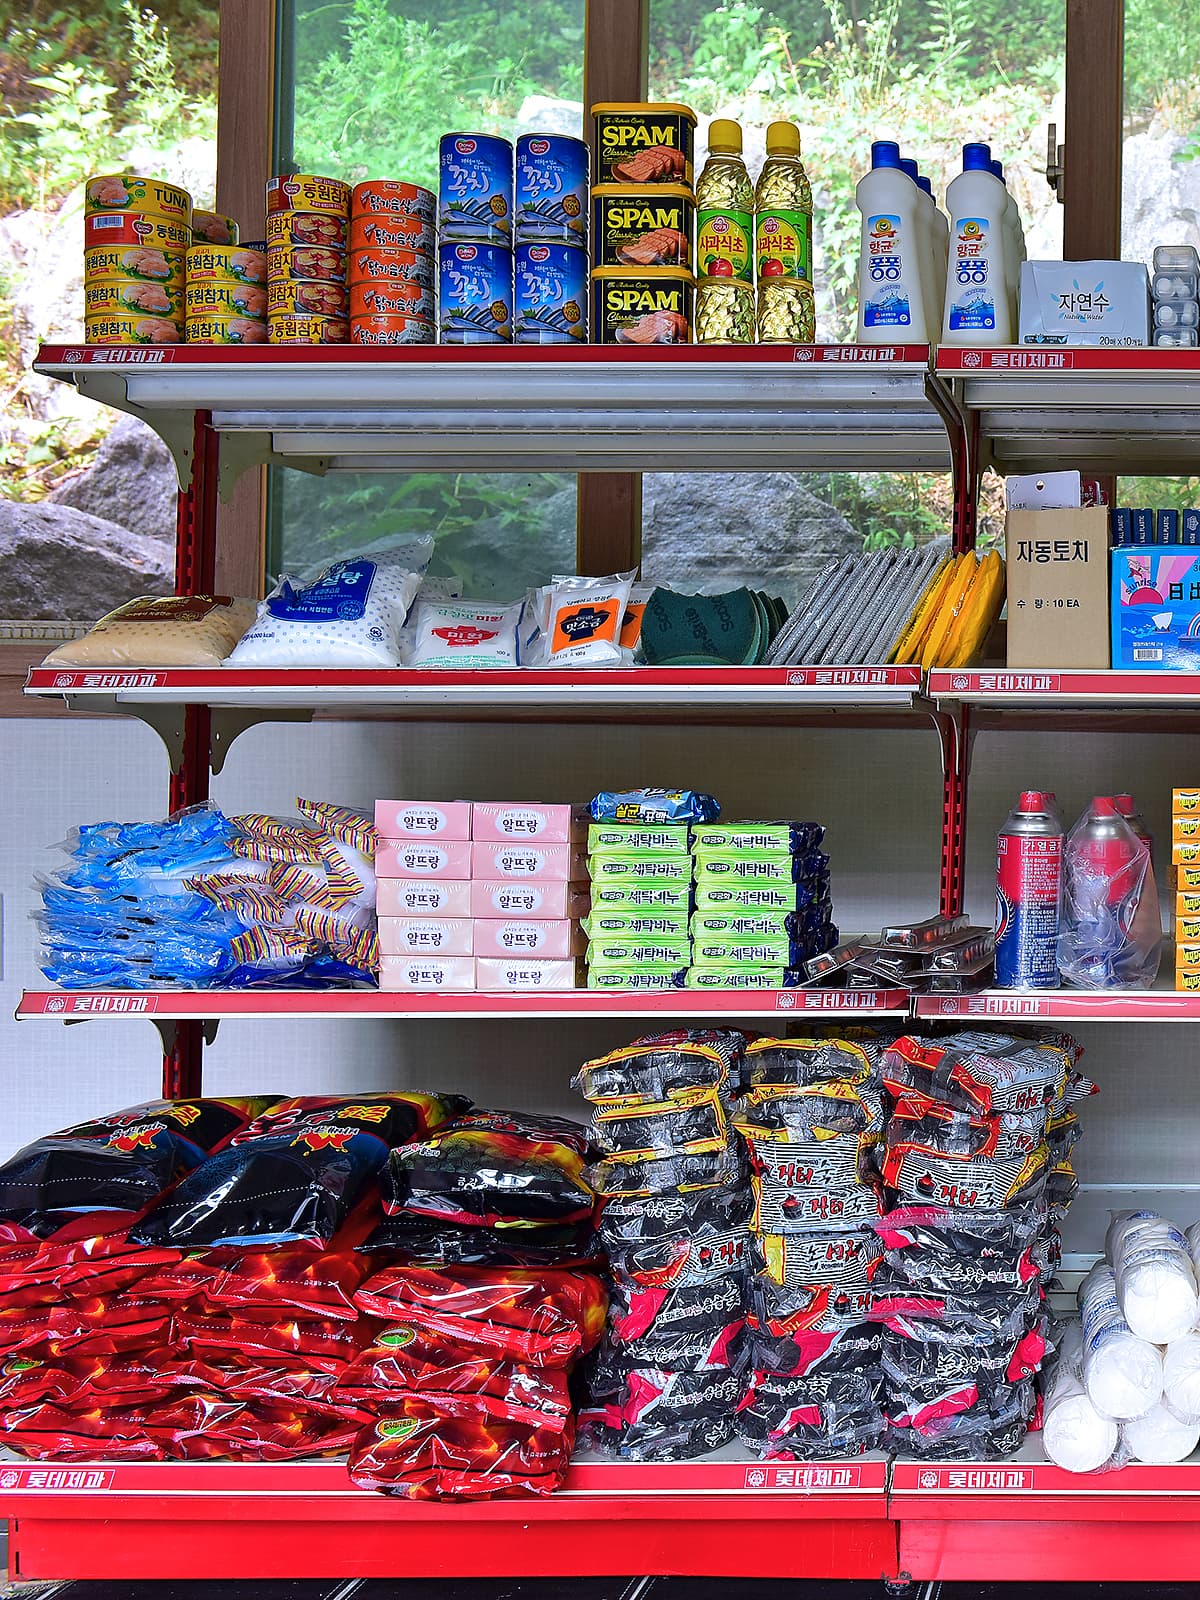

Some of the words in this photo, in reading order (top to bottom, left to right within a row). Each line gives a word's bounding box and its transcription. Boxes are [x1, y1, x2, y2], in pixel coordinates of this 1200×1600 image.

[602, 126, 674, 146] SPAM
[448, 165, 490, 197] 꽁치
[522, 165, 563, 197] 꽁치
[154, 188, 188, 209] TUNA
[369, 195, 413, 215] 닭가슴살
[606, 208, 679, 229] SPAM
[374, 228, 418, 249] 닭가슴살
[700, 235, 744, 252] 사과식초
[869, 241, 892, 255] 항균
[957, 244, 980, 258] 항균
[367, 260, 411, 281] 닭가슴살
[869, 256, 901, 281] 퐁퐁
[956, 259, 988, 284] 퐁퐁
[448, 272, 491, 304] 꽁치
[522, 272, 563, 304] 꽁치
[374, 294, 418, 315] 닭가슴살
[606, 291, 679, 311] SPAM
[1058, 293, 1110, 313] 자연수
[359, 329, 400, 344] 닭가슴살
[90, 349, 165, 363] 롯데제과
[823, 349, 896, 361] 롯데제과
[991, 355, 1066, 367] 롯데제과
[1017, 540, 1089, 563] 자동토치
[1125, 578, 1158, 595] sunrise
[1017, 600, 1026, 608] 수
[1034, 599, 1043, 608] 량
[1053, 600, 1063, 608] 10
[1066, 600, 1080, 608] EA
[566, 618, 601, 634] 맛소금
[447, 631, 483, 639] 미원
[82, 673, 158, 687] 롯데제과
[815, 671, 888, 684] 롯데제과
[979, 676, 1052, 690] 롯데제과
[403, 816, 439, 831] 알뜨랑
[502, 819, 538, 833] 알뜨랑
[626, 833, 679, 848] 세탁비누
[729, 835, 781, 848] 세탁비누
[404, 855, 440, 869] 알뜨랑
[501, 857, 537, 871] 알뜨랑
[631, 863, 683, 878] 세탁비누
[733, 863, 785, 877] 세탁비누
[405, 893, 440, 908] 알뜨랑
[499, 895, 535, 909] 알뜨랑
[628, 891, 680, 904] 세탁비누
[735, 891, 787, 905] 세탁비누
[628, 919, 679, 933] 세탁비누
[730, 919, 781, 934] 세탁비누
[407, 932, 442, 947] 알뜨랑
[502, 934, 538, 947] 알뜨랑
[630, 947, 681, 961] 세탁비누
[729, 947, 780, 961] 세탁비누
[408, 970, 444, 984] 알뜨랑
[506, 970, 542, 985] 알뜨랑
[626, 975, 675, 988] 세탁비누
[724, 975, 775, 987] 세탁비누
[73, 997, 148, 1012] 롯데제과
[804, 993, 877, 1008] 롯데제과
[967, 999, 1041, 1013] 롯데제과
[26, 1470, 105, 1489] 롯데제과
[776, 1470, 852, 1488] 롯데제과
[947, 1470, 1025, 1488] 롯데제과
